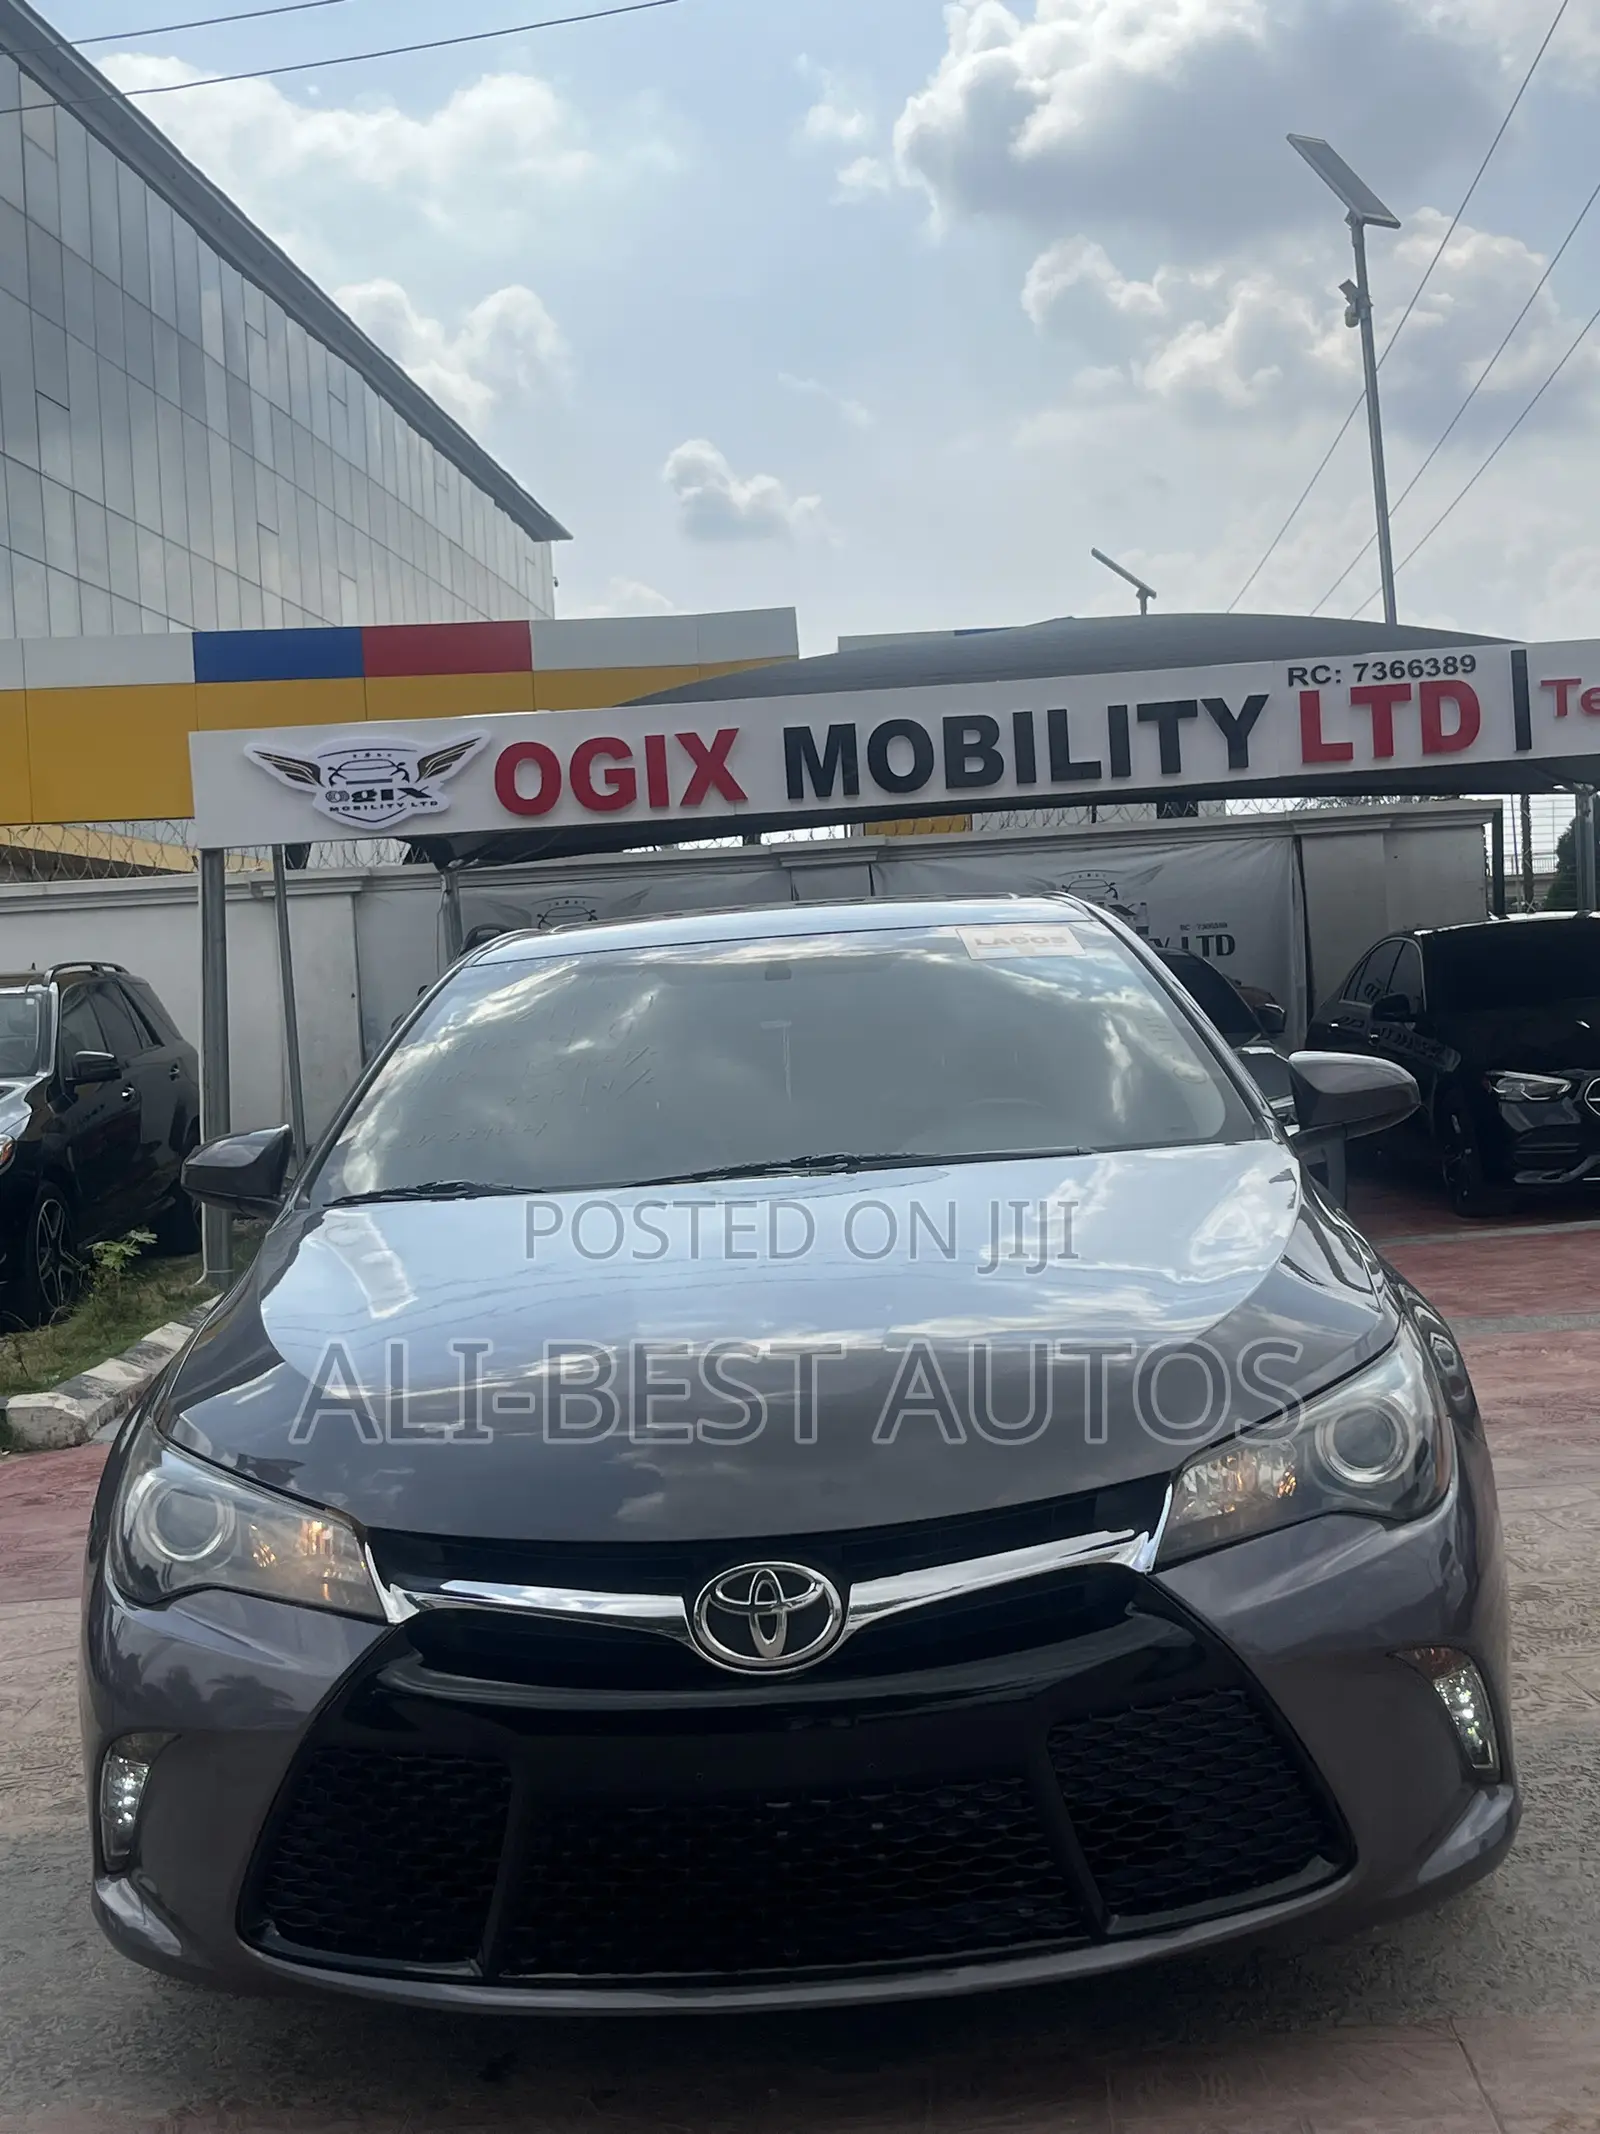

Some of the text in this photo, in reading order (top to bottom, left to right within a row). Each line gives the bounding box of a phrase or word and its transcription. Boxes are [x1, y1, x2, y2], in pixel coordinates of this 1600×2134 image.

[1287, 654, 1477, 687] RC: 7366389
[494, 679, 1481, 816] OGIX MOBILITY LTD
[329, 800, 438, 812] MOBILITY LTD
